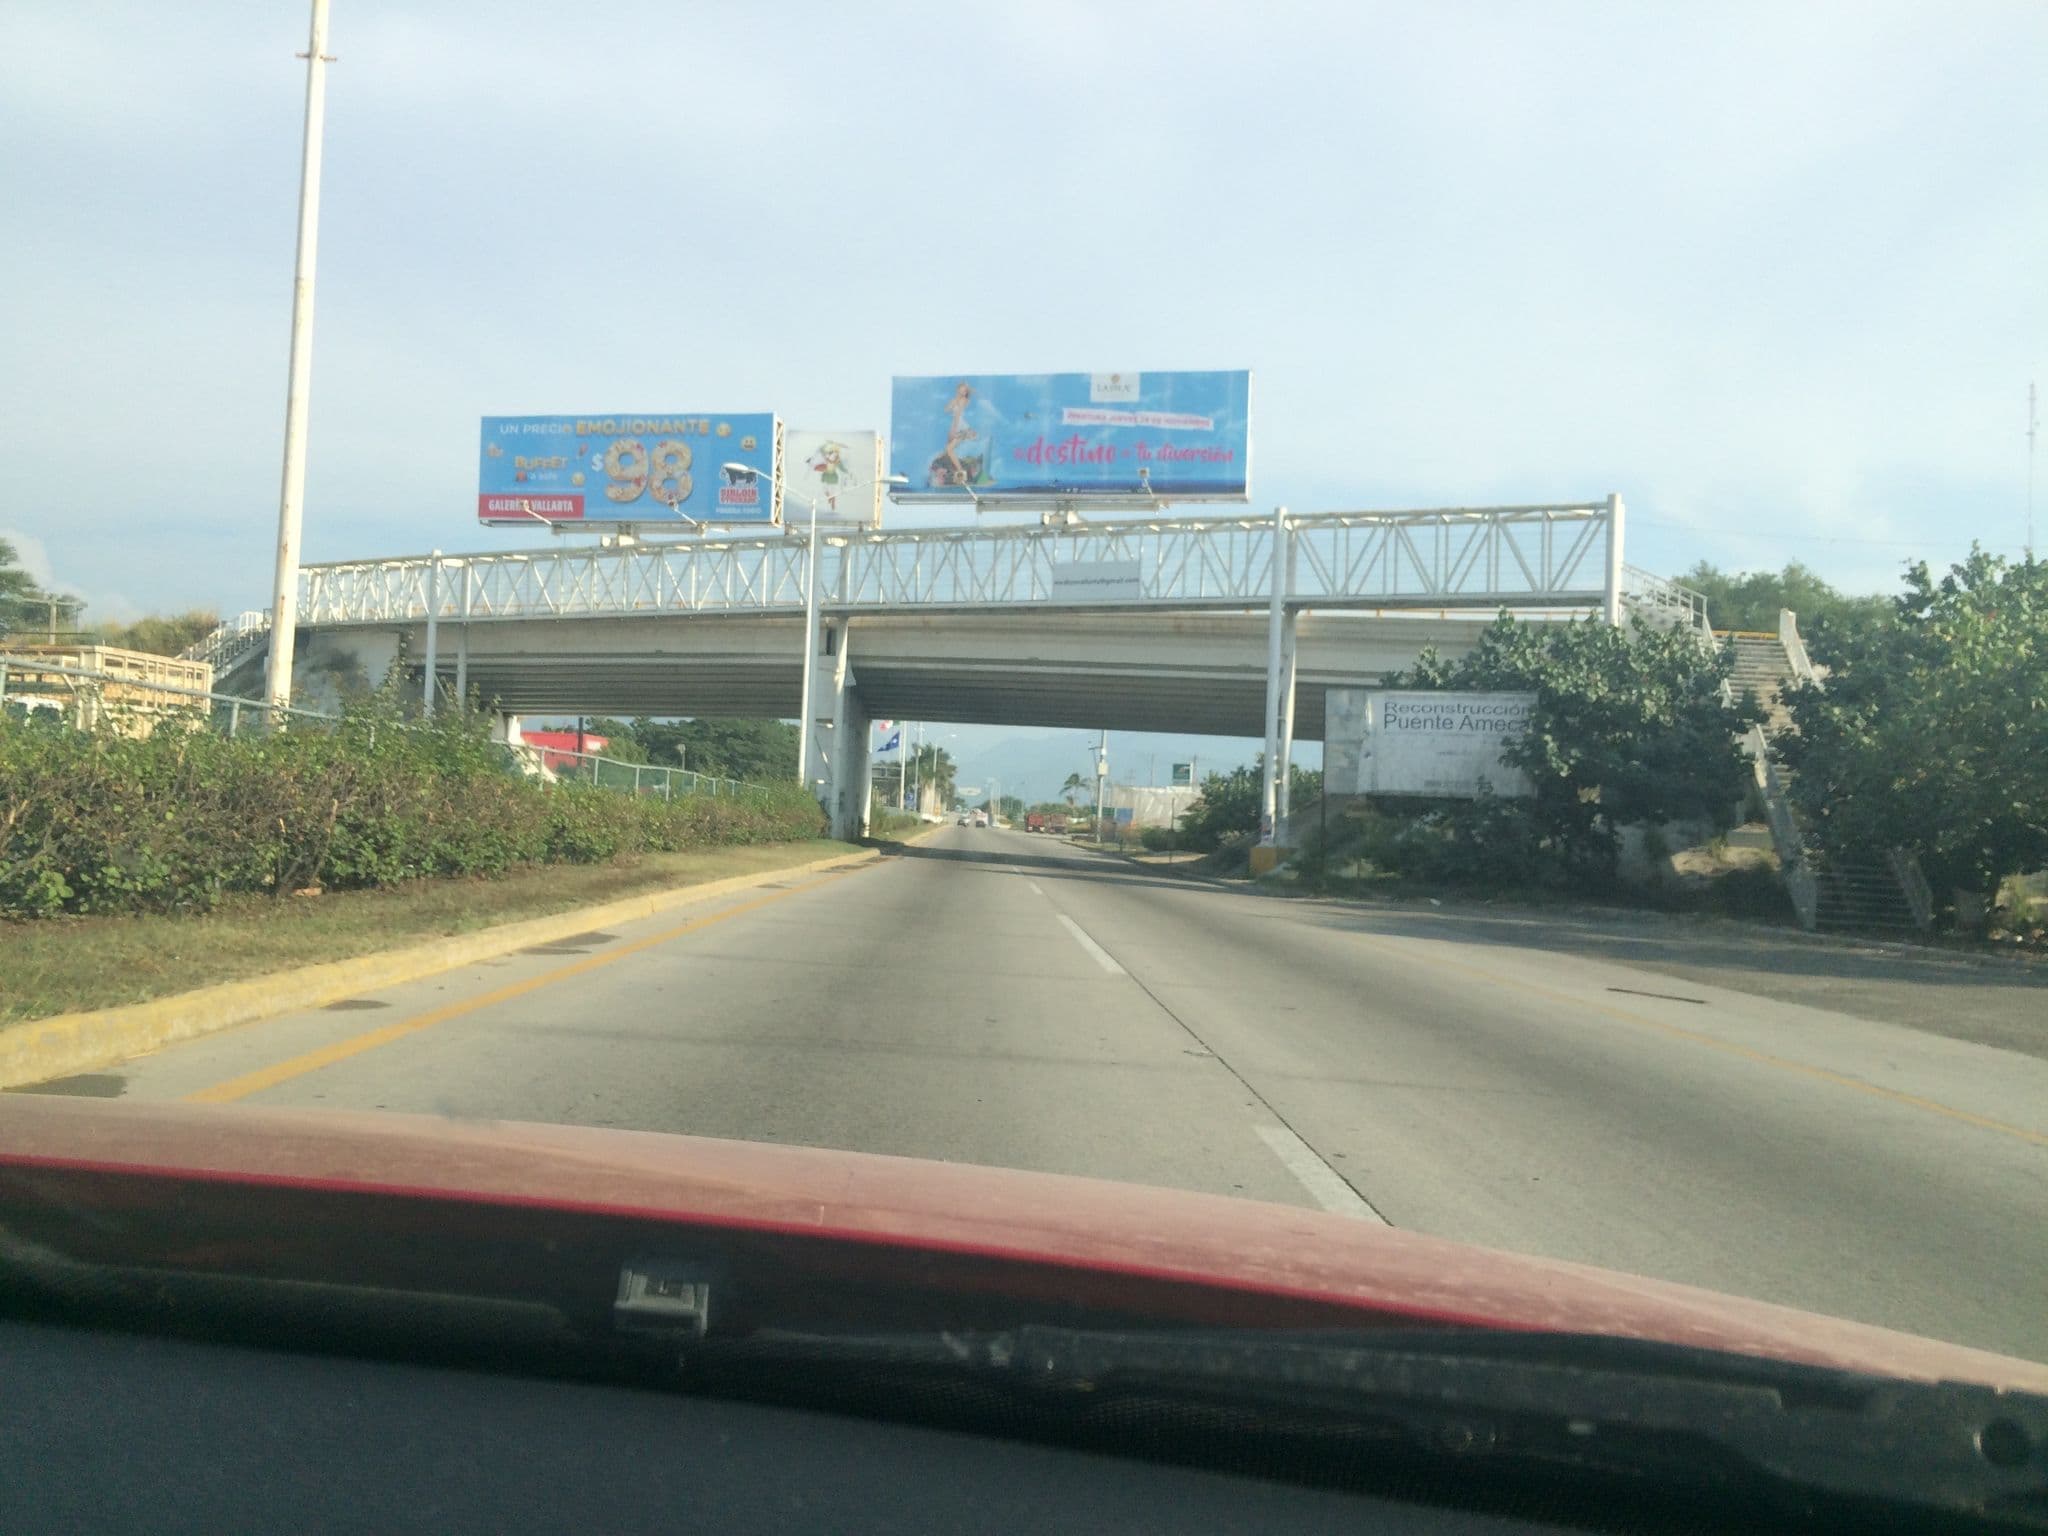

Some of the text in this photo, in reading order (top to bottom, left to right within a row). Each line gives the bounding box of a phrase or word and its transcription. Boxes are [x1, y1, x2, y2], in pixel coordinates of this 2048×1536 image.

[500, 418, 709, 436] UN PRECIO EMOJIONANTE
[531, 499, 574, 512] VALLARTA
[1384, 714, 1453, 731] Puente
